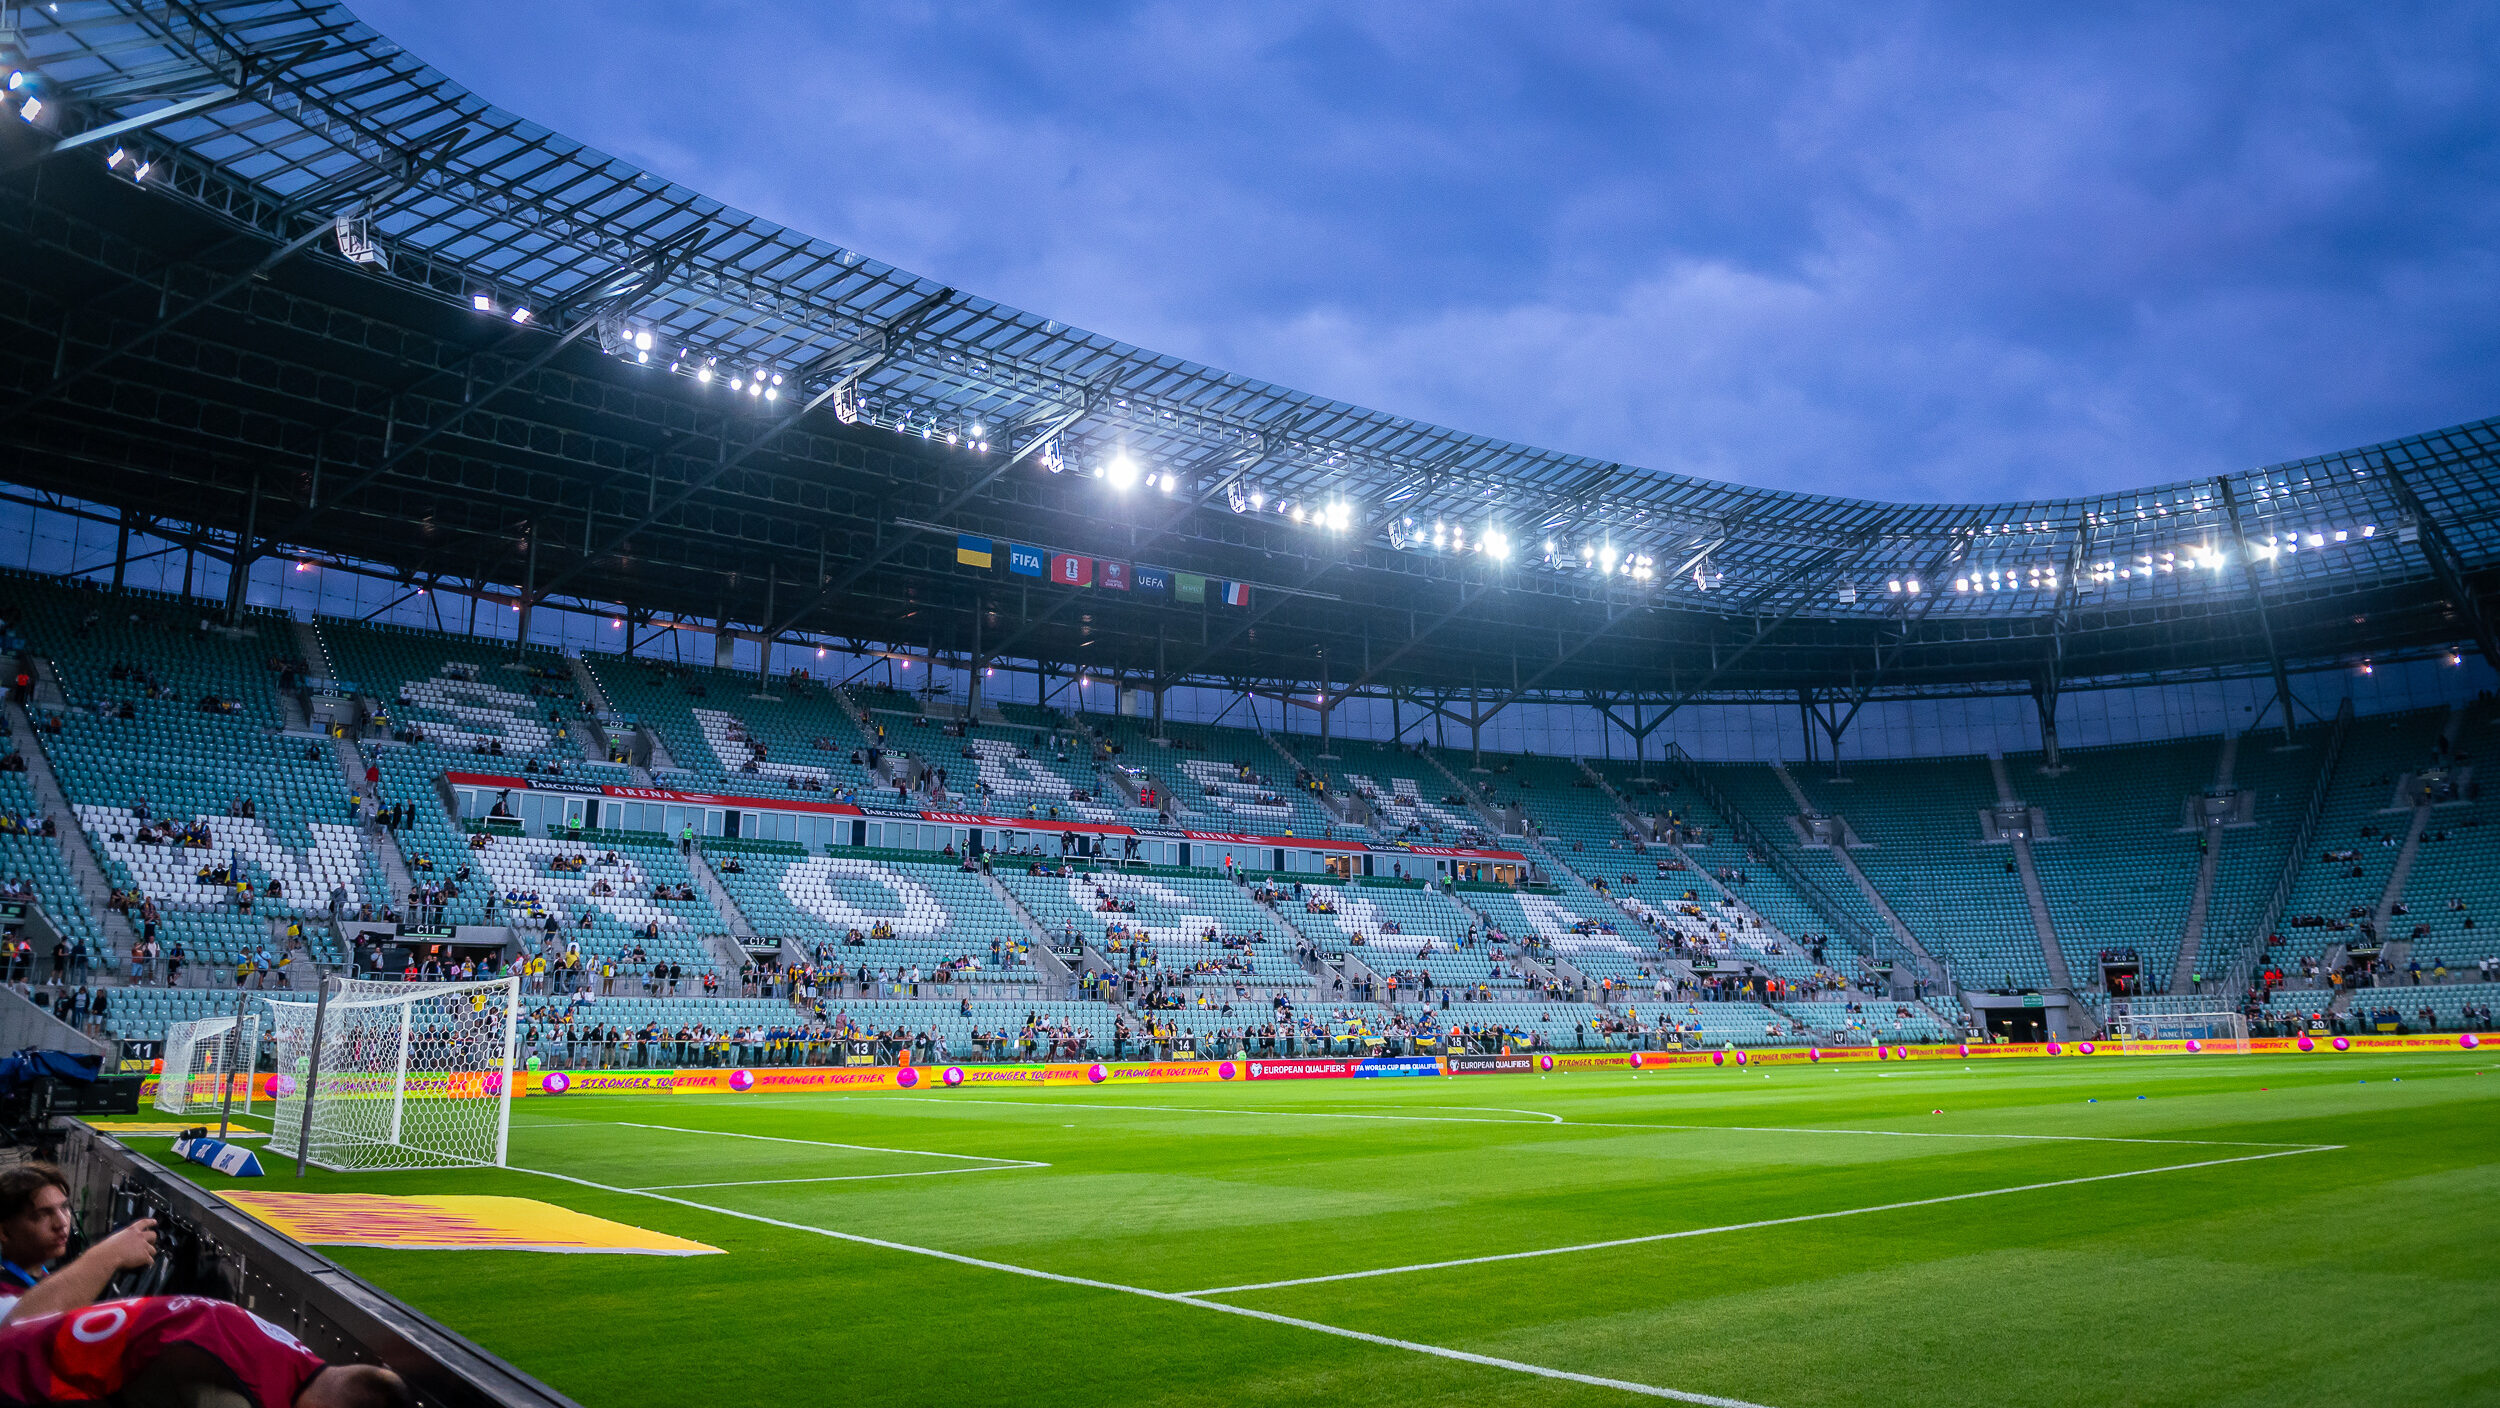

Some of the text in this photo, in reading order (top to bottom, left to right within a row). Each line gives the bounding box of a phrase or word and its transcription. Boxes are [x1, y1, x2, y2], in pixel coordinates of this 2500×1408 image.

[1012, 552, 1039, 569] FIFA
[1138, 576, 1164, 588] UEFA
[323, 689, 338, 697] C21
[610, 720, 624, 728] C22
[886, 749, 898, 757] C23
[528, 779, 675, 799] TARCZYŃSKI ARENA
[931, 813, 981, 823] ARENA
[1192, 831, 1235, 841] ARENA
[1415, 846, 1454, 855] ARENA
[417, 924, 436, 934] C11
[750, 937, 766, 945] C12
[1057, 946, 1071, 954] C13
[2114, 1025, 2127, 1035] 19
[2311, 1020, 2325, 1030] 20
[1969, 1028, 1979, 1037] 18
[1451, 1037, 1462, 1047] 15
[1669, 1033, 1679, 1043] 16
[1834, 1032, 1844, 1044] 17
[1178, 1039, 1190, 1051] 14
[2101, 1042, 2179, 1051] STRONGER TOGETHER
[2251, 1041, 2290, 1050] TOGETHER
[2355, 1039, 2403, 1048] STRONGER
[132, 1043, 152, 1058] 11
[853, 1043, 869, 1055] 13
[2003, 1046, 2039, 1054] TOGETHER
[1558, 1057, 1625, 1067] STRONGER TOGETHER
[1750, 1053, 1779, 1062] STRONGER
[1263, 1064, 1346, 1075] EUROPEAN QUALIFIERS
[1365, 1064, 1386, 1072] WORLD
[1460, 1060, 1530, 1069] EUROPEAN QUALIFIERS
[972, 1070, 1079, 1081] STRONGER TOGETHER
[1113, 1067, 1210, 1078] STRONGER TOGETHER
[580, 1076, 717, 1089] STRONGER TOGETHER
[761, 1073, 885, 1086] STRONGER TOGETHER
